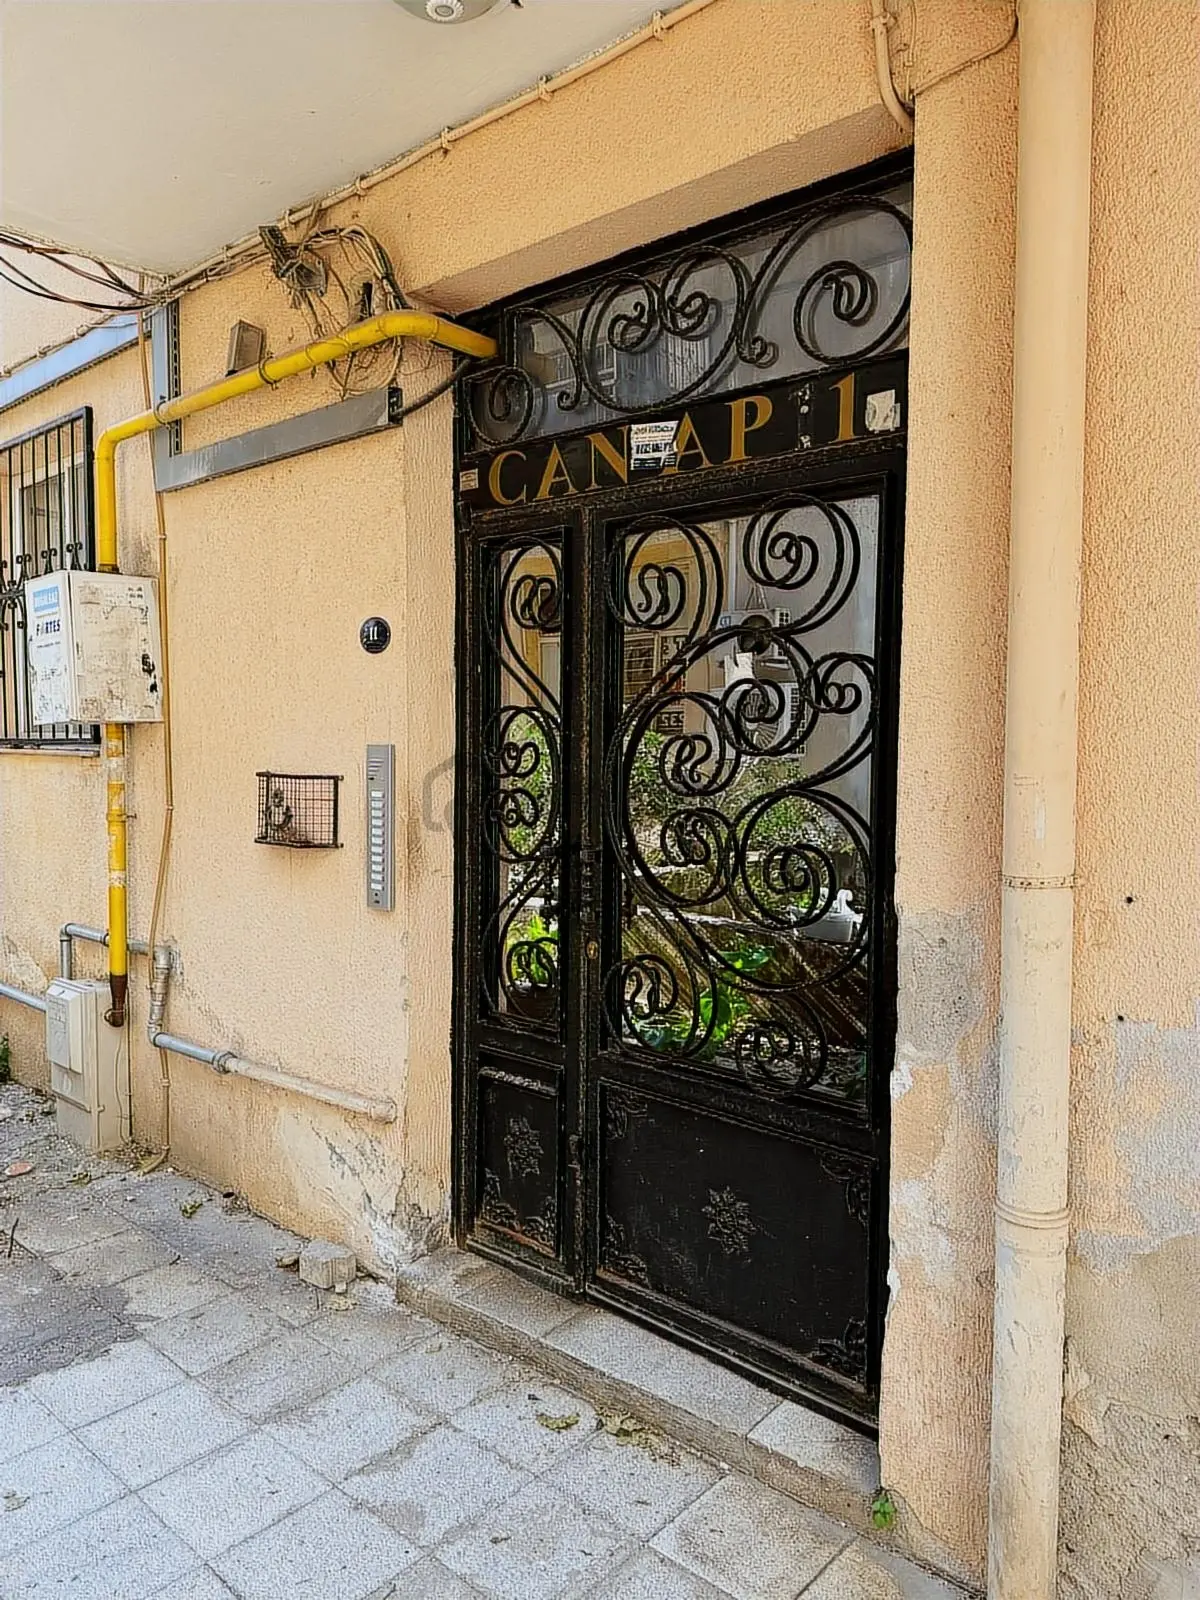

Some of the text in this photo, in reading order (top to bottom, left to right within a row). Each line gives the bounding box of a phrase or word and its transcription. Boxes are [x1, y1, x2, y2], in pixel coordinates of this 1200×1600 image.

[488, 372, 864, 506] CAN AP 1
[36, 619, 61, 637] FRTES
